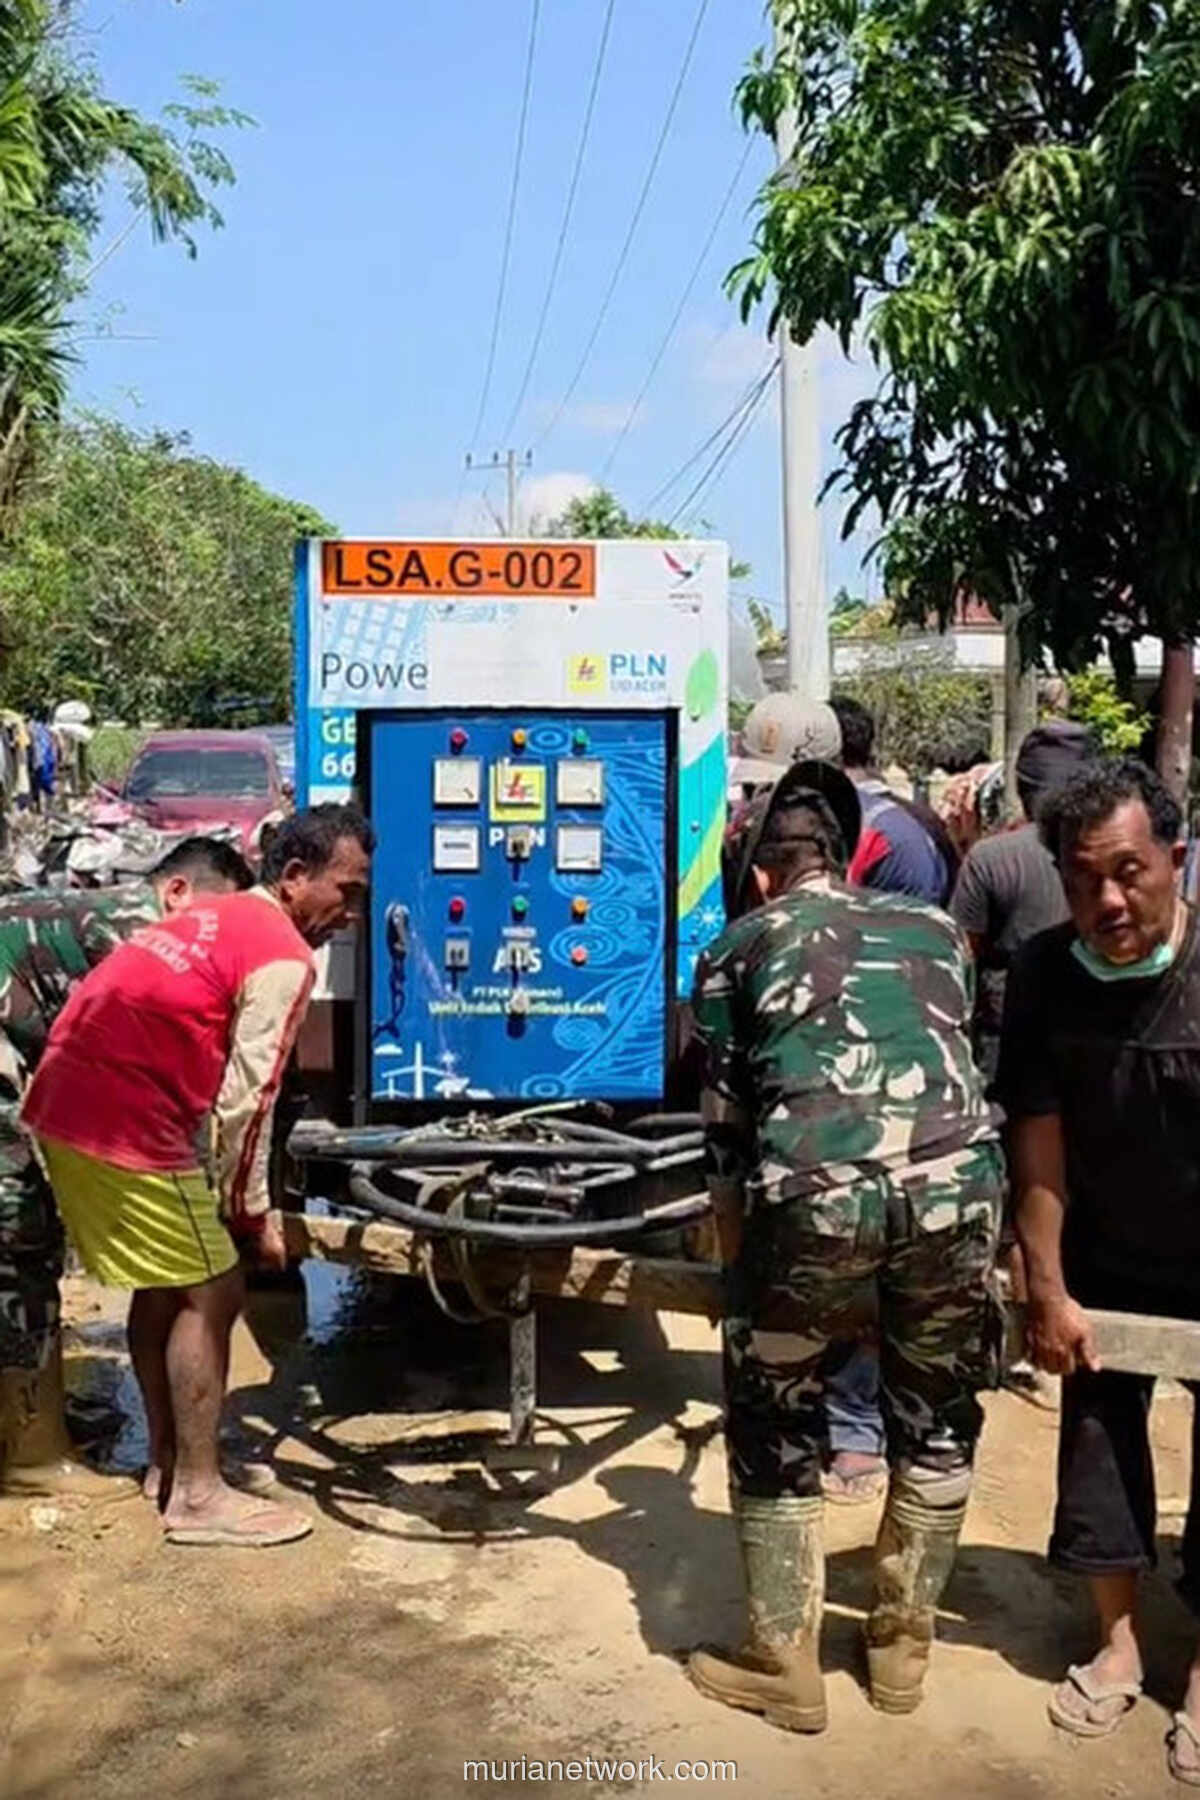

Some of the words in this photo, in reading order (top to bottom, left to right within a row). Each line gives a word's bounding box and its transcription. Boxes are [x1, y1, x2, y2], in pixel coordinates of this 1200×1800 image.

[334, 549, 582, 588] LSA.G-002
[321, 651, 428, 690] Powe
[609, 653, 667, 677] PLN
[489, 827, 546, 847] PN
